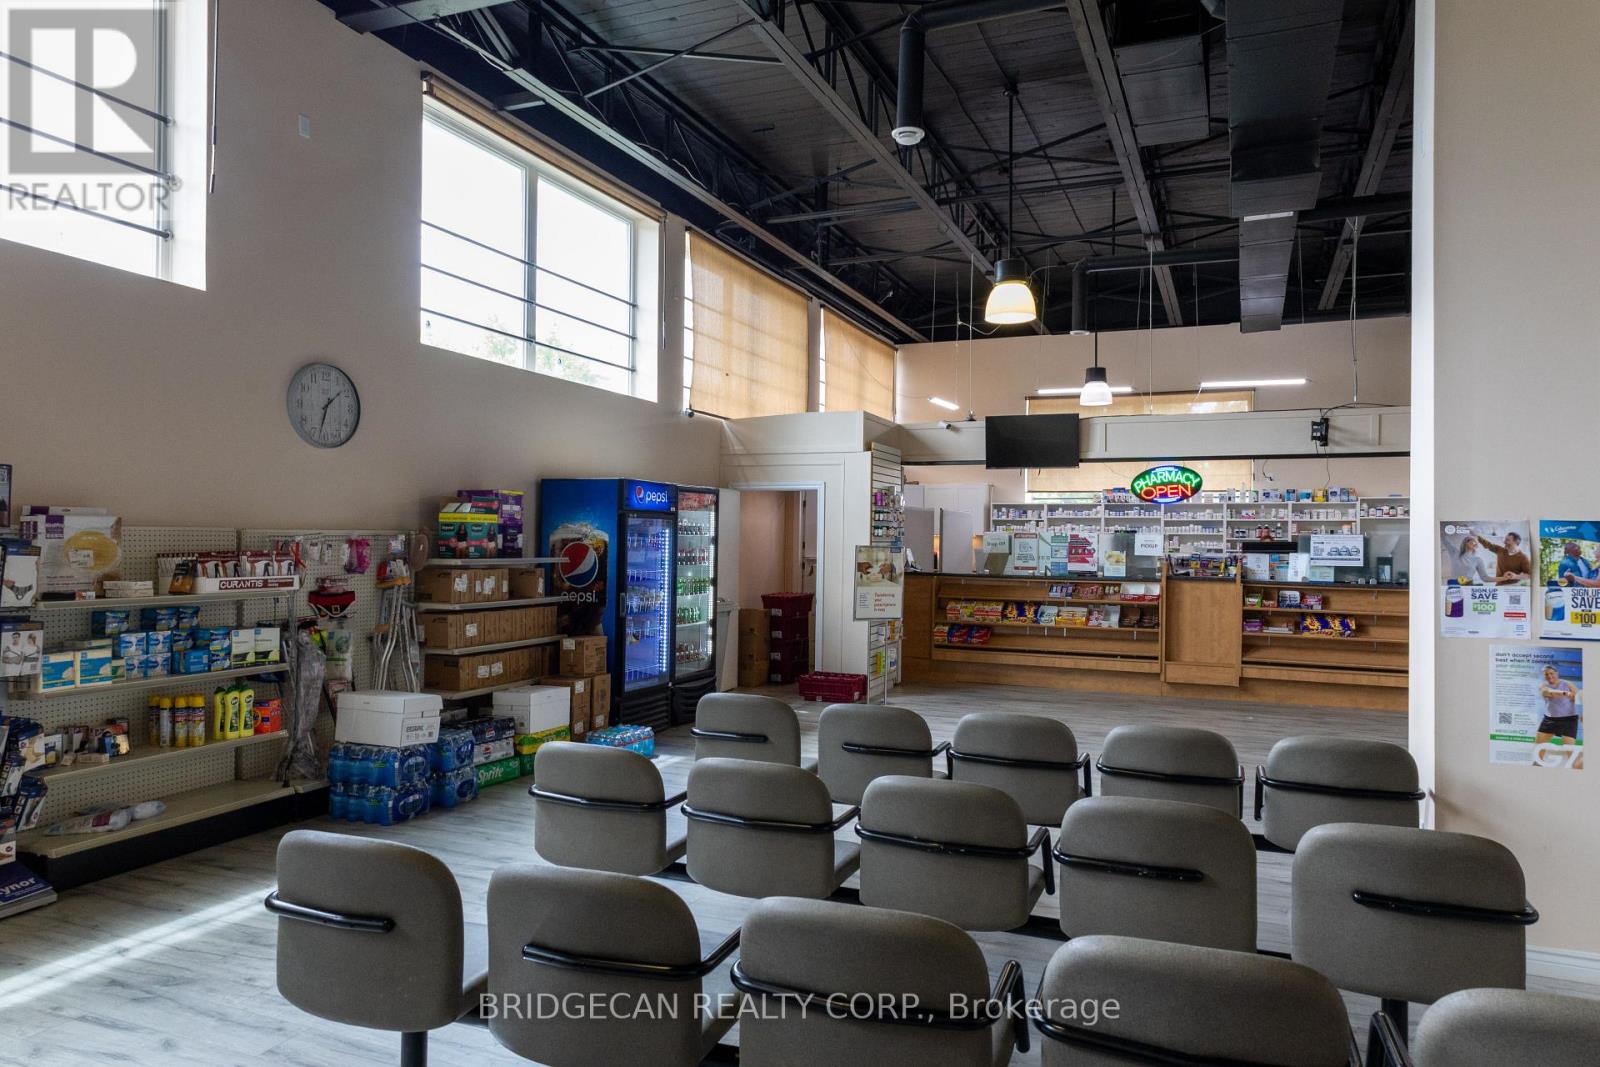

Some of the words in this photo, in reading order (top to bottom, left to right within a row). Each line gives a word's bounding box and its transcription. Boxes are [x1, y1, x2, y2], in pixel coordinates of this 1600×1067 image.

[1133, 470, 1201, 494] PHARMACY
[645, 490, 668, 503] pepsi
[1141, 484, 1192, 500] OPEN
[219, 580, 263, 589] CURANTIS
[560, 590, 596, 605] pepsi
[1571, 588, 1589, 597] SIGN
[1571, 597, 1600, 609] SAVE
[1573, 613, 1597, 624] $100
[478, 767, 504, 785] Sprite
